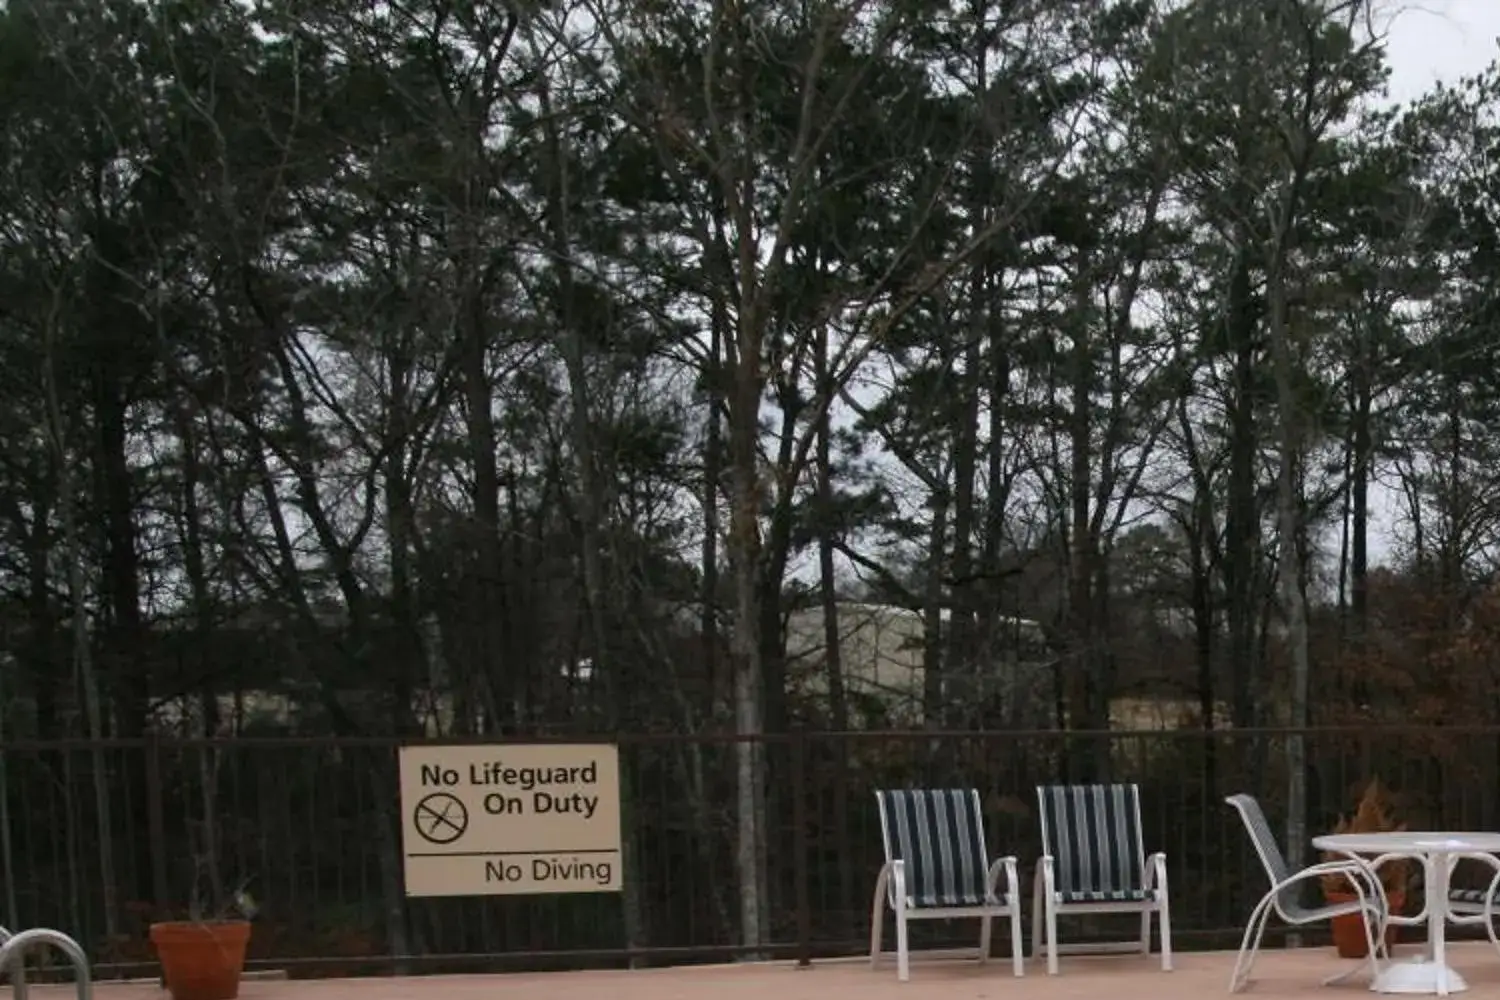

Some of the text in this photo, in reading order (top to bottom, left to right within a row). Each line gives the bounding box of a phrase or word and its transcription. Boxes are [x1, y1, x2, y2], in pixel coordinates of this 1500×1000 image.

[421, 761, 597, 791] No Lifeguard
[483, 791, 599, 820] On Duty
[485, 857, 613, 885] No Diving
